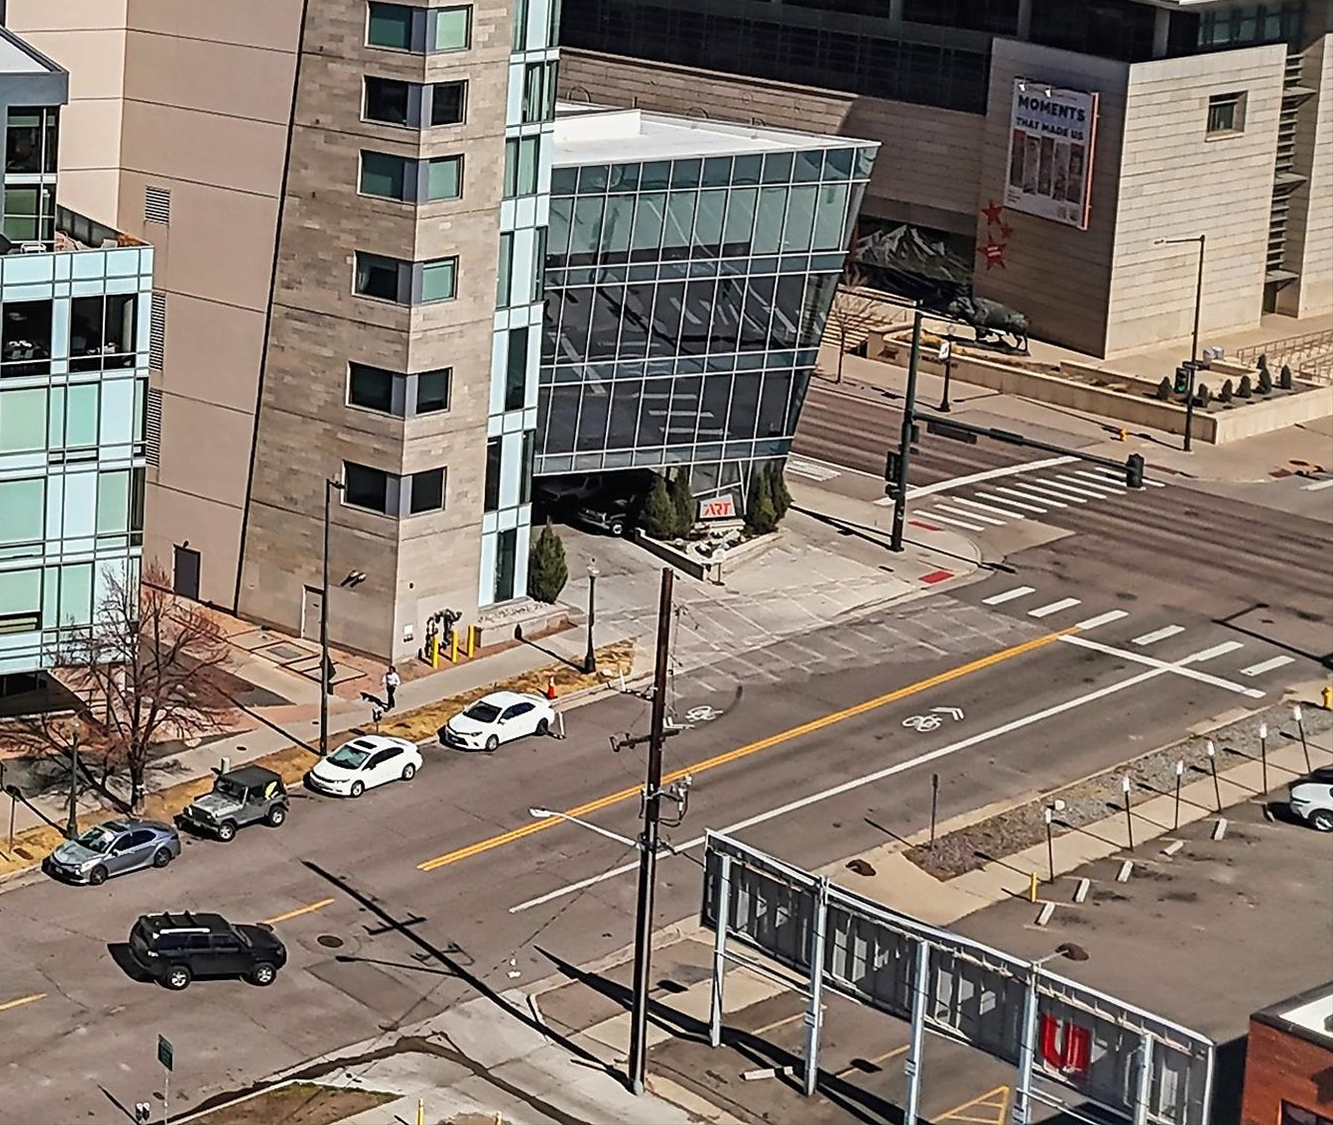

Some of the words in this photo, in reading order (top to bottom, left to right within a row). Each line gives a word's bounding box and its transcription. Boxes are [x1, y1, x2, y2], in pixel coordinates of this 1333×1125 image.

[1018, 95, 1085, 122] MOMENTS
[1016, 117, 1039, 130] THAT
[1042, 123, 1069, 137] MADE
[1071, 130, 1084, 141] US
[705, 502, 731, 515] ART
